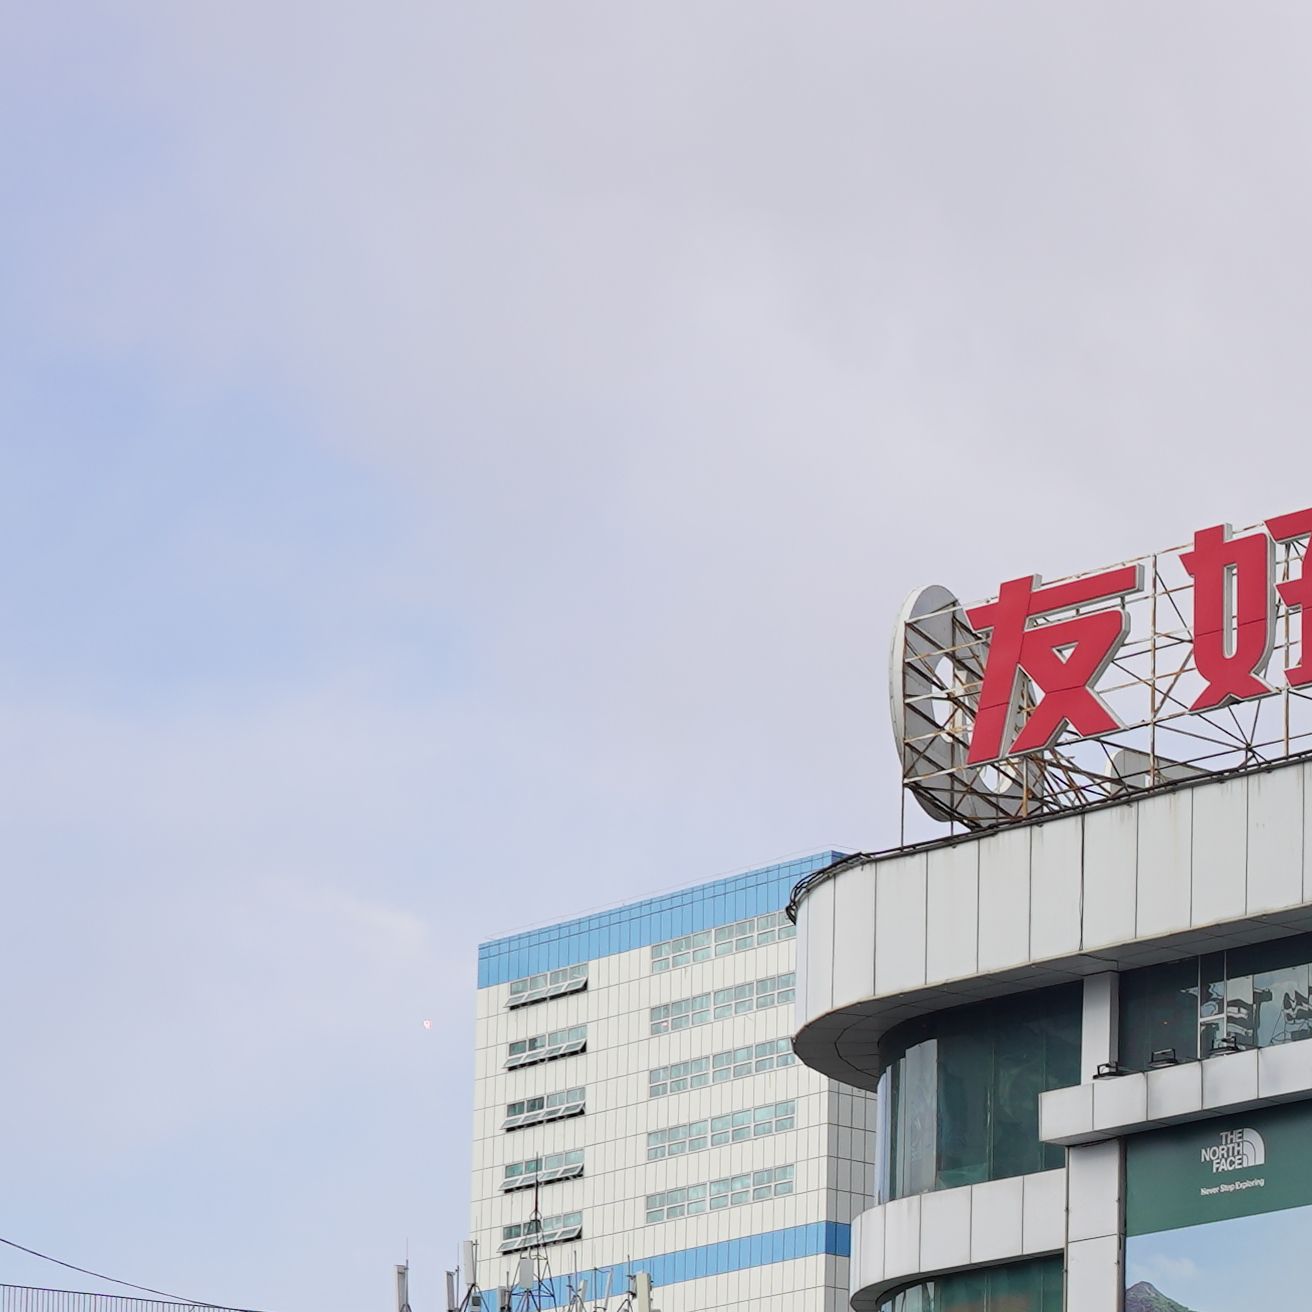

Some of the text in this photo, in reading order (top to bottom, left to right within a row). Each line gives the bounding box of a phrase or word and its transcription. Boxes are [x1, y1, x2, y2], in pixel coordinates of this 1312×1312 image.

[1220, 1129, 1243, 1145] THE
[1201, 1142, 1243, 1163] NORTH
[1213, 1155, 1243, 1173] FACE
